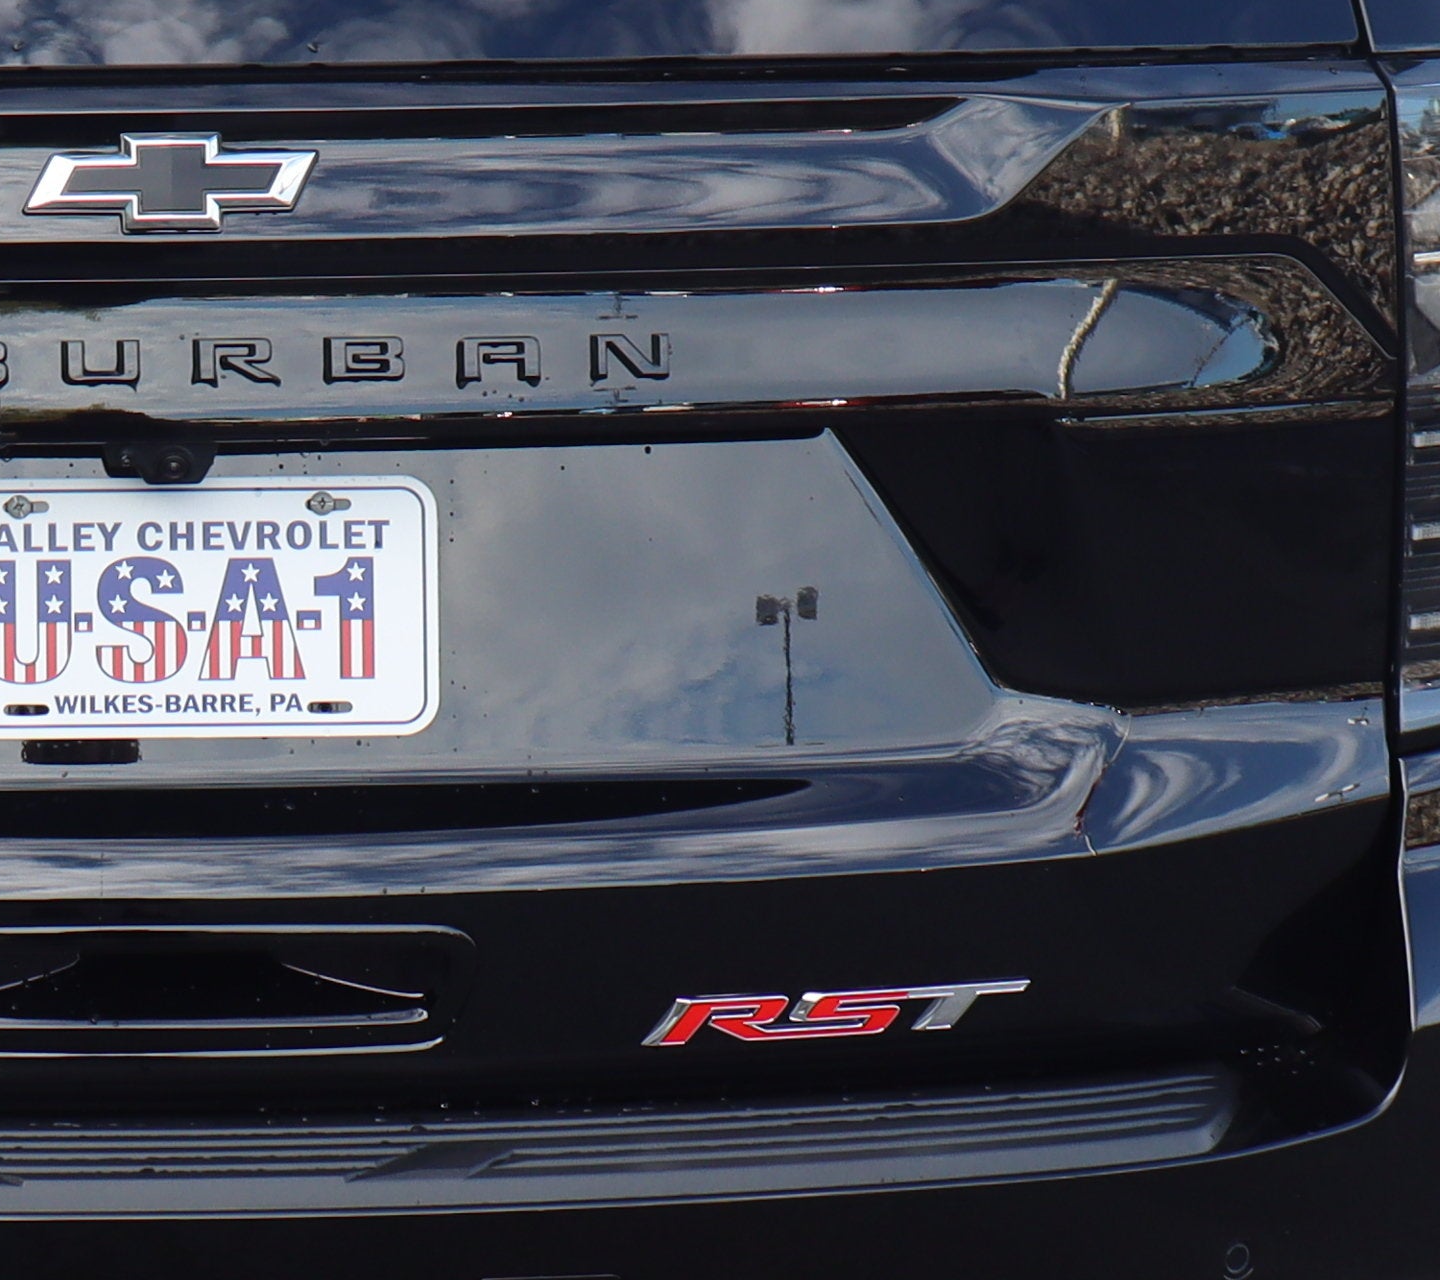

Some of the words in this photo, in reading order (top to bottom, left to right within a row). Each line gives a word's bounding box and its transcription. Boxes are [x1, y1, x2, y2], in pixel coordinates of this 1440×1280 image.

[136, 519, 390, 552] CHEVROLET
[53, 693, 262, 717] WILKES-BARRE,
[270, 693, 304, 713] PA
[640, 976, 1032, 1047] RST
